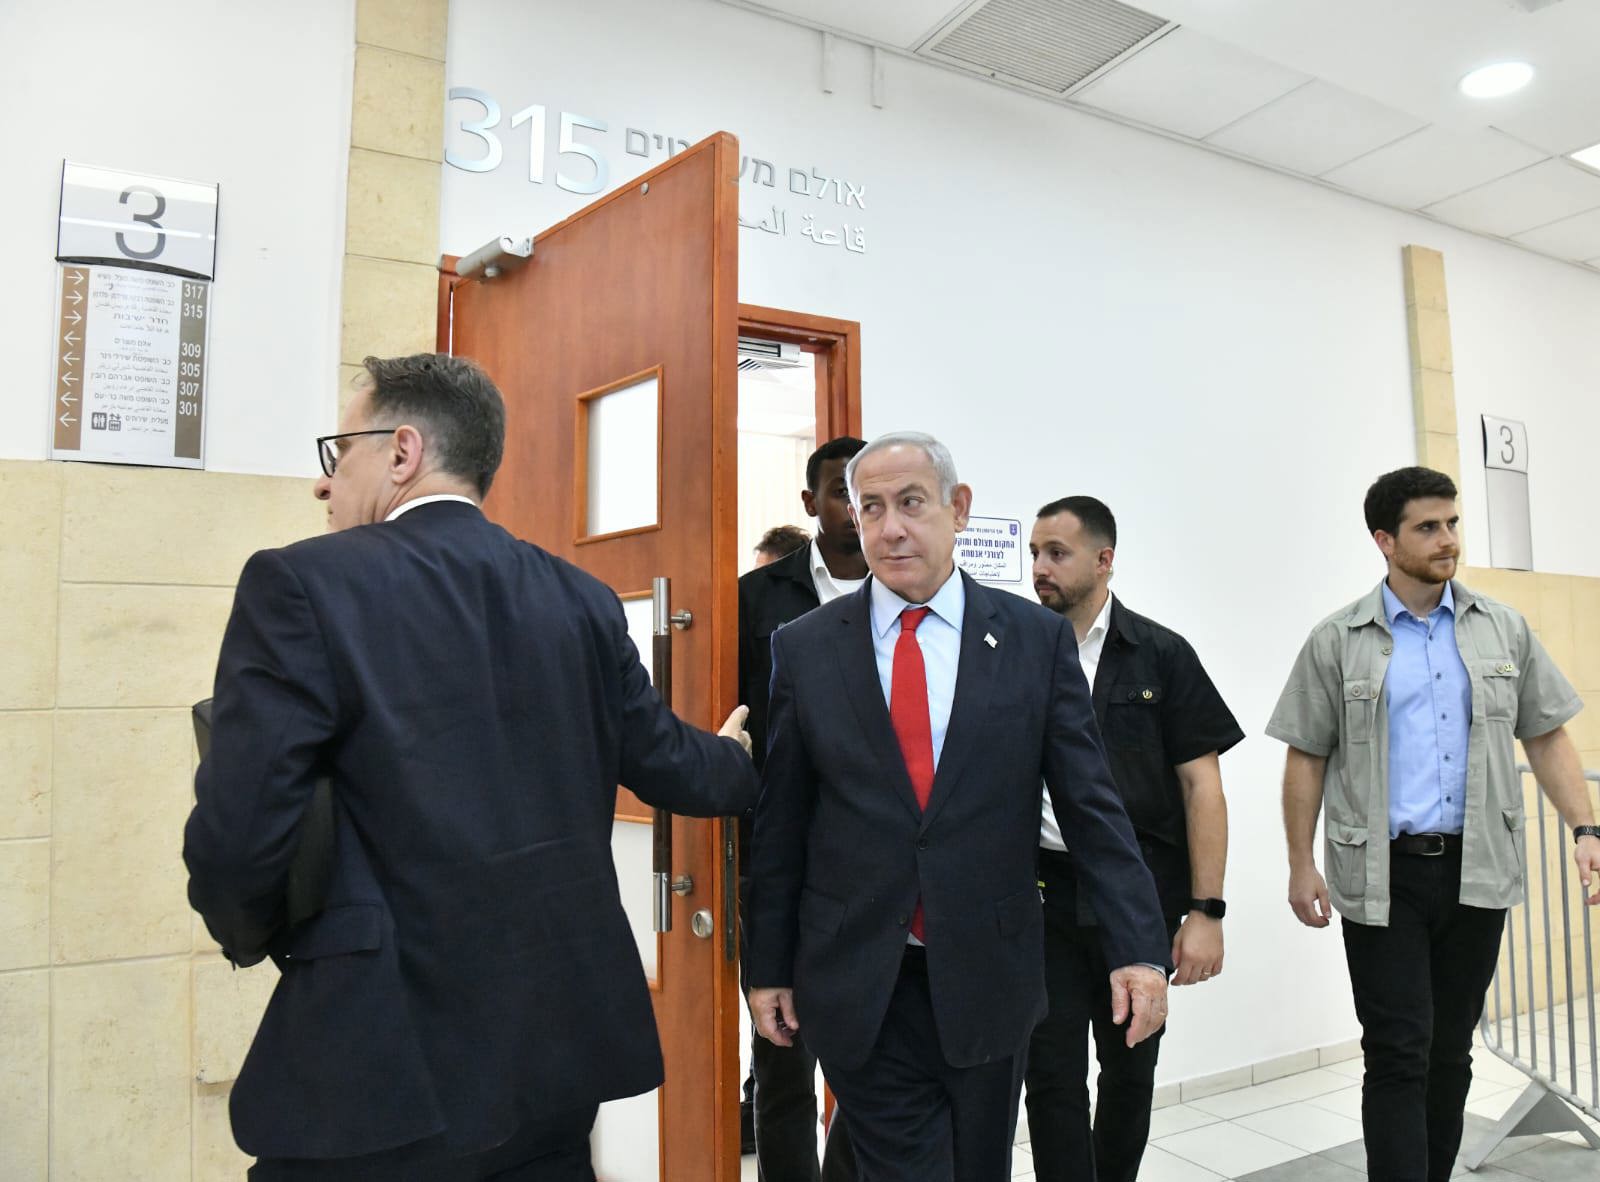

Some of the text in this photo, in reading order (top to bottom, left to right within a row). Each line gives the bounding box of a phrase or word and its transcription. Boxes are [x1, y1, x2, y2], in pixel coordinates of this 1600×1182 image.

[444, 86, 609, 195] 315
[790, 166, 866, 209] אולם
[115, 185, 167, 260] 3
[800, 214, 866, 254] قاعة
[184, 284, 205, 299] 317
[183, 303, 203, 319] 315
[181, 342, 201, 358] 309
[180, 362, 200, 378] 305
[179, 382, 199, 397] 307
[179, 401, 198, 416] 301
[1500, 425, 1515, 464] 3
[974, 537, 993, 547] מצולם
[995, 539, 1015, 549] המקום
[961, 549, 983, 558] אבטחה
